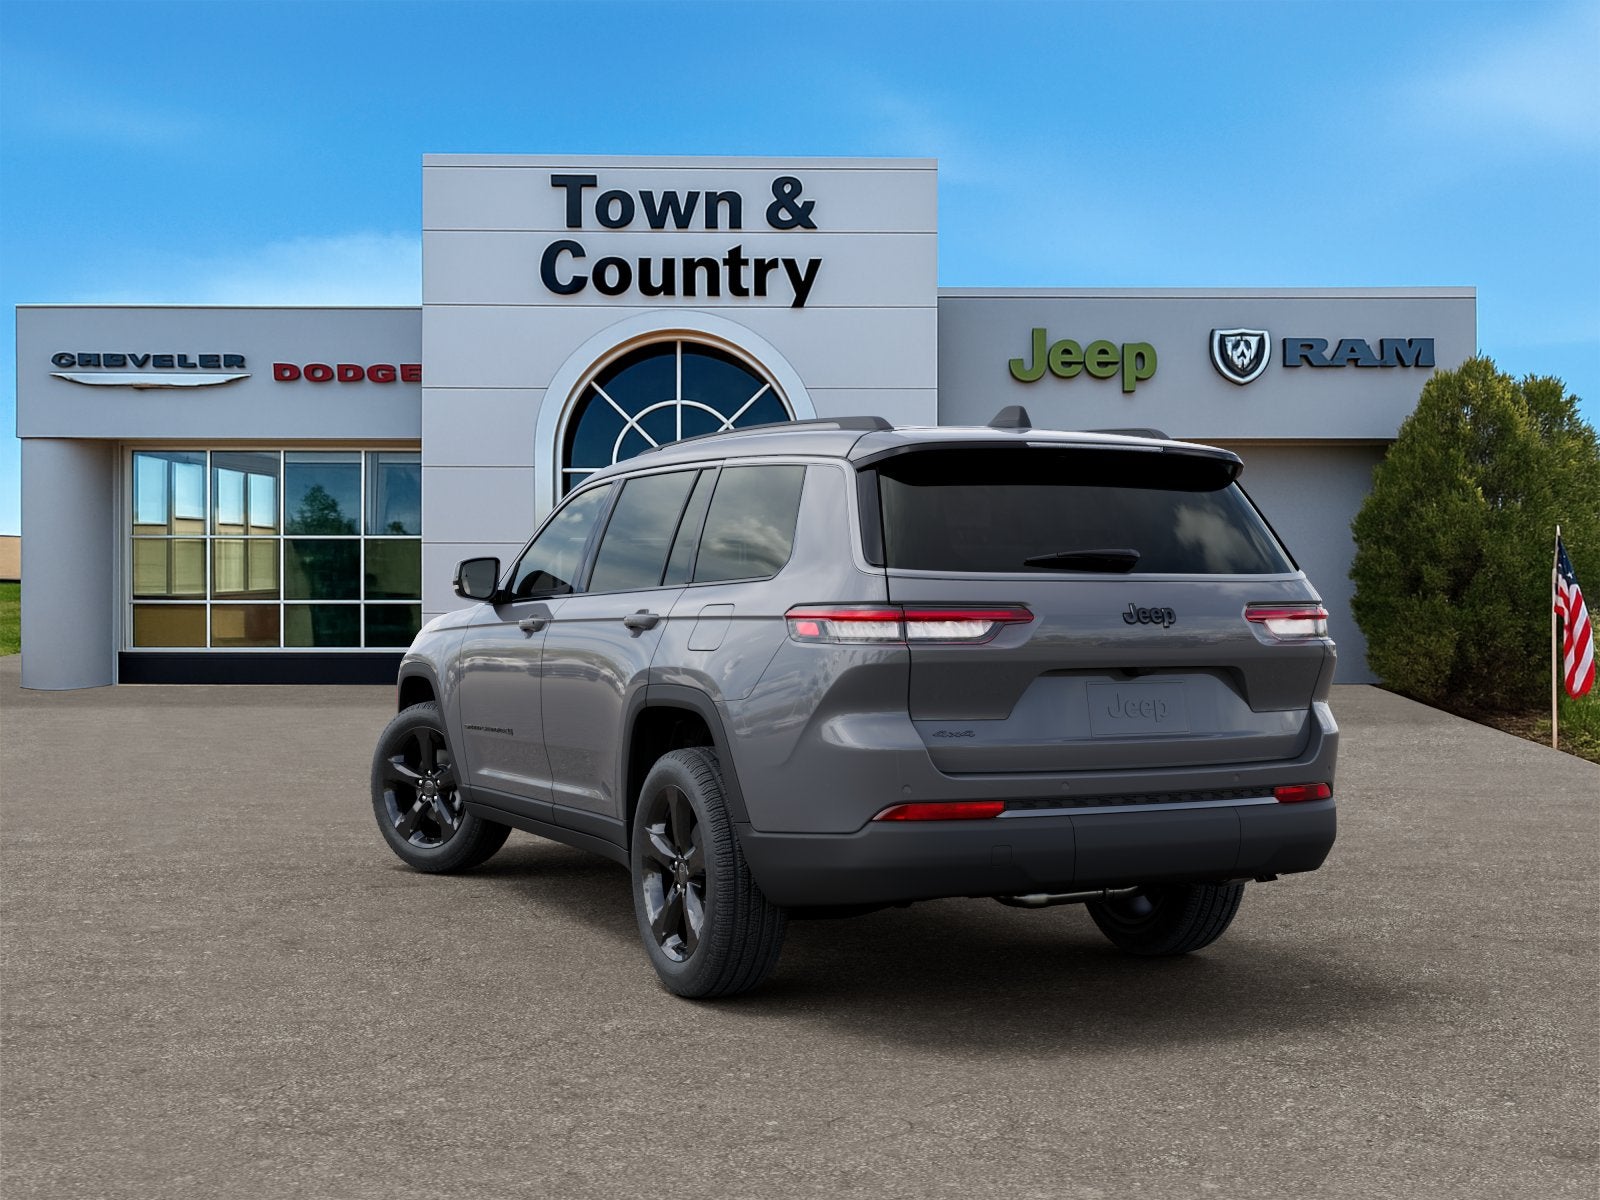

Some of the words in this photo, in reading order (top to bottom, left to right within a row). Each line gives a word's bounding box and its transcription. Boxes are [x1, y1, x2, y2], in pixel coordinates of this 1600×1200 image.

[550, 174, 742, 230] Town
[765, 176, 818, 230] &
[540, 239, 822, 308] Country
[1009, 328, 1158, 393] Jeep
[1283, 337, 1435, 368] RAM
[273, 363, 422, 383] DODGE
[1122, 603, 1177, 628] Jeep
[1107, 692, 1167, 723] Jeep
